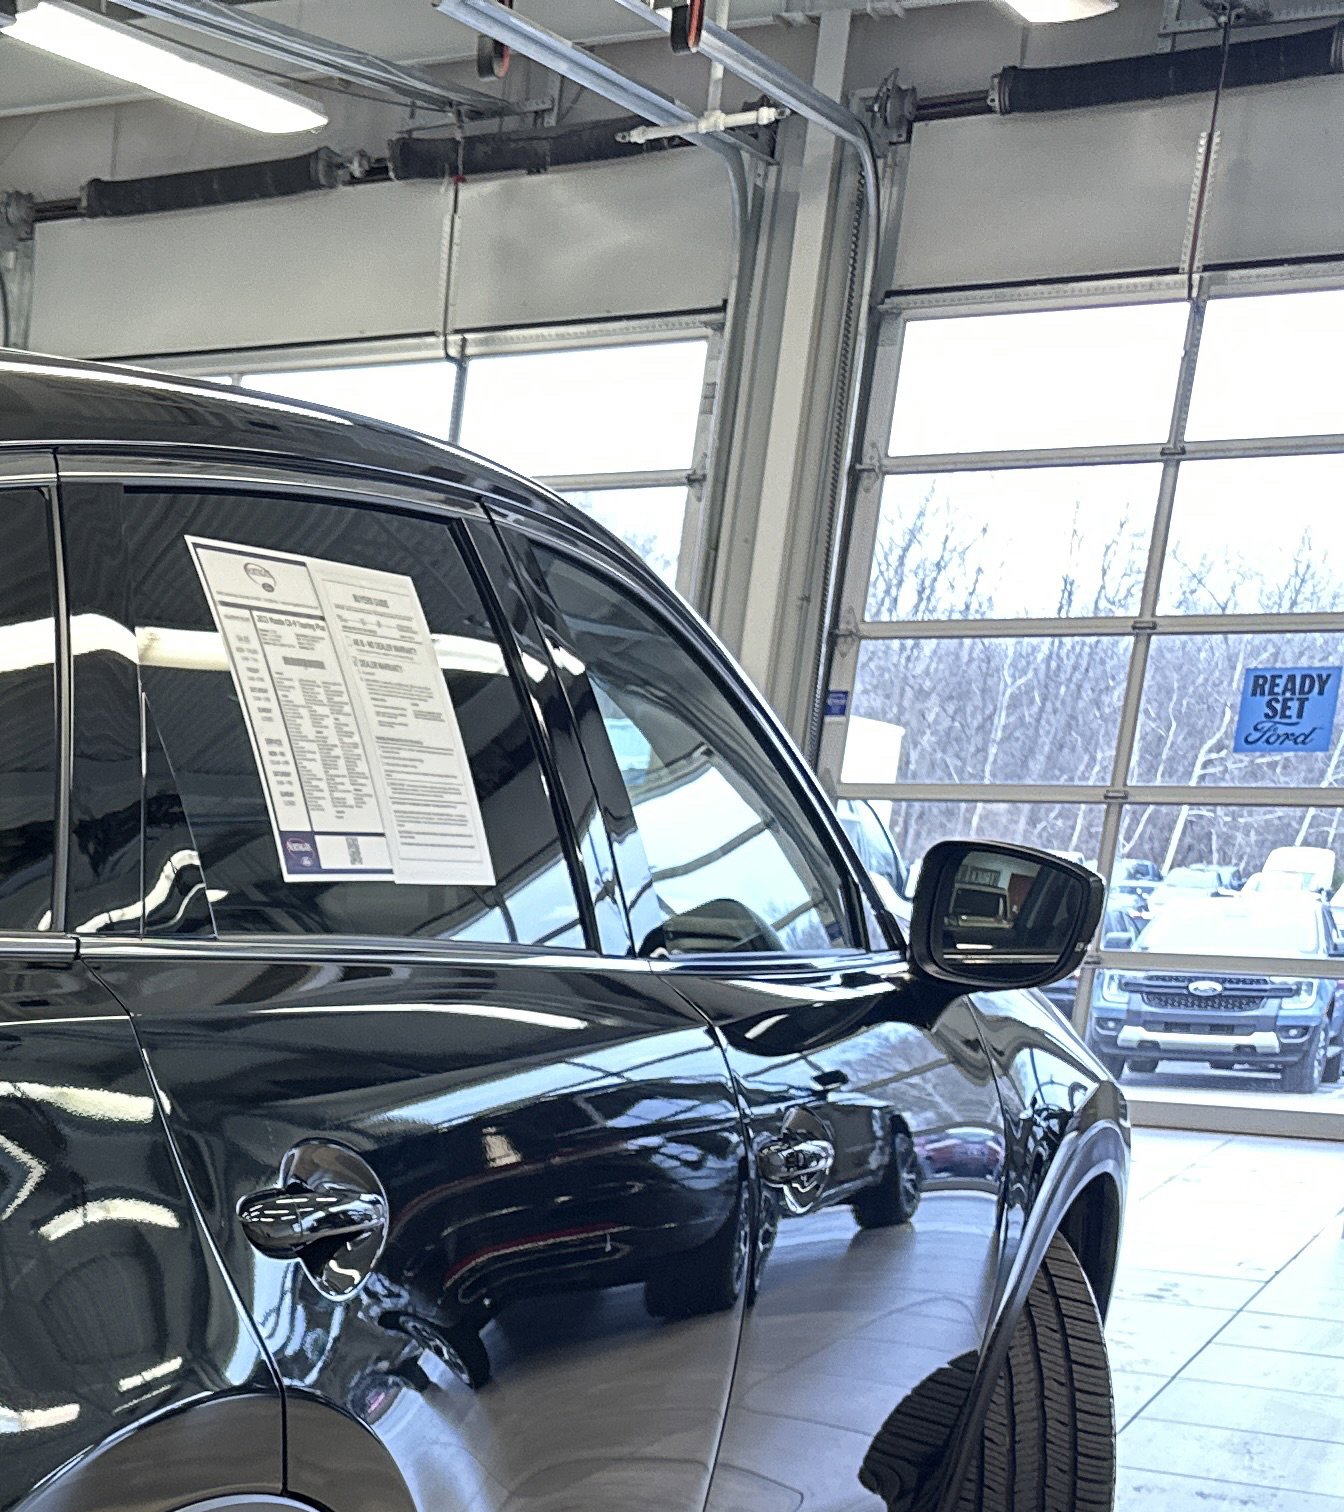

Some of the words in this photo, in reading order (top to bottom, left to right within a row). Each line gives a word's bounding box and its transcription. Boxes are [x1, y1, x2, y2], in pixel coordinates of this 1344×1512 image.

[1250, 673, 1332, 697] READY
[1263, 697, 1310, 720] SET
[1243, 720, 1324, 746] Ford
